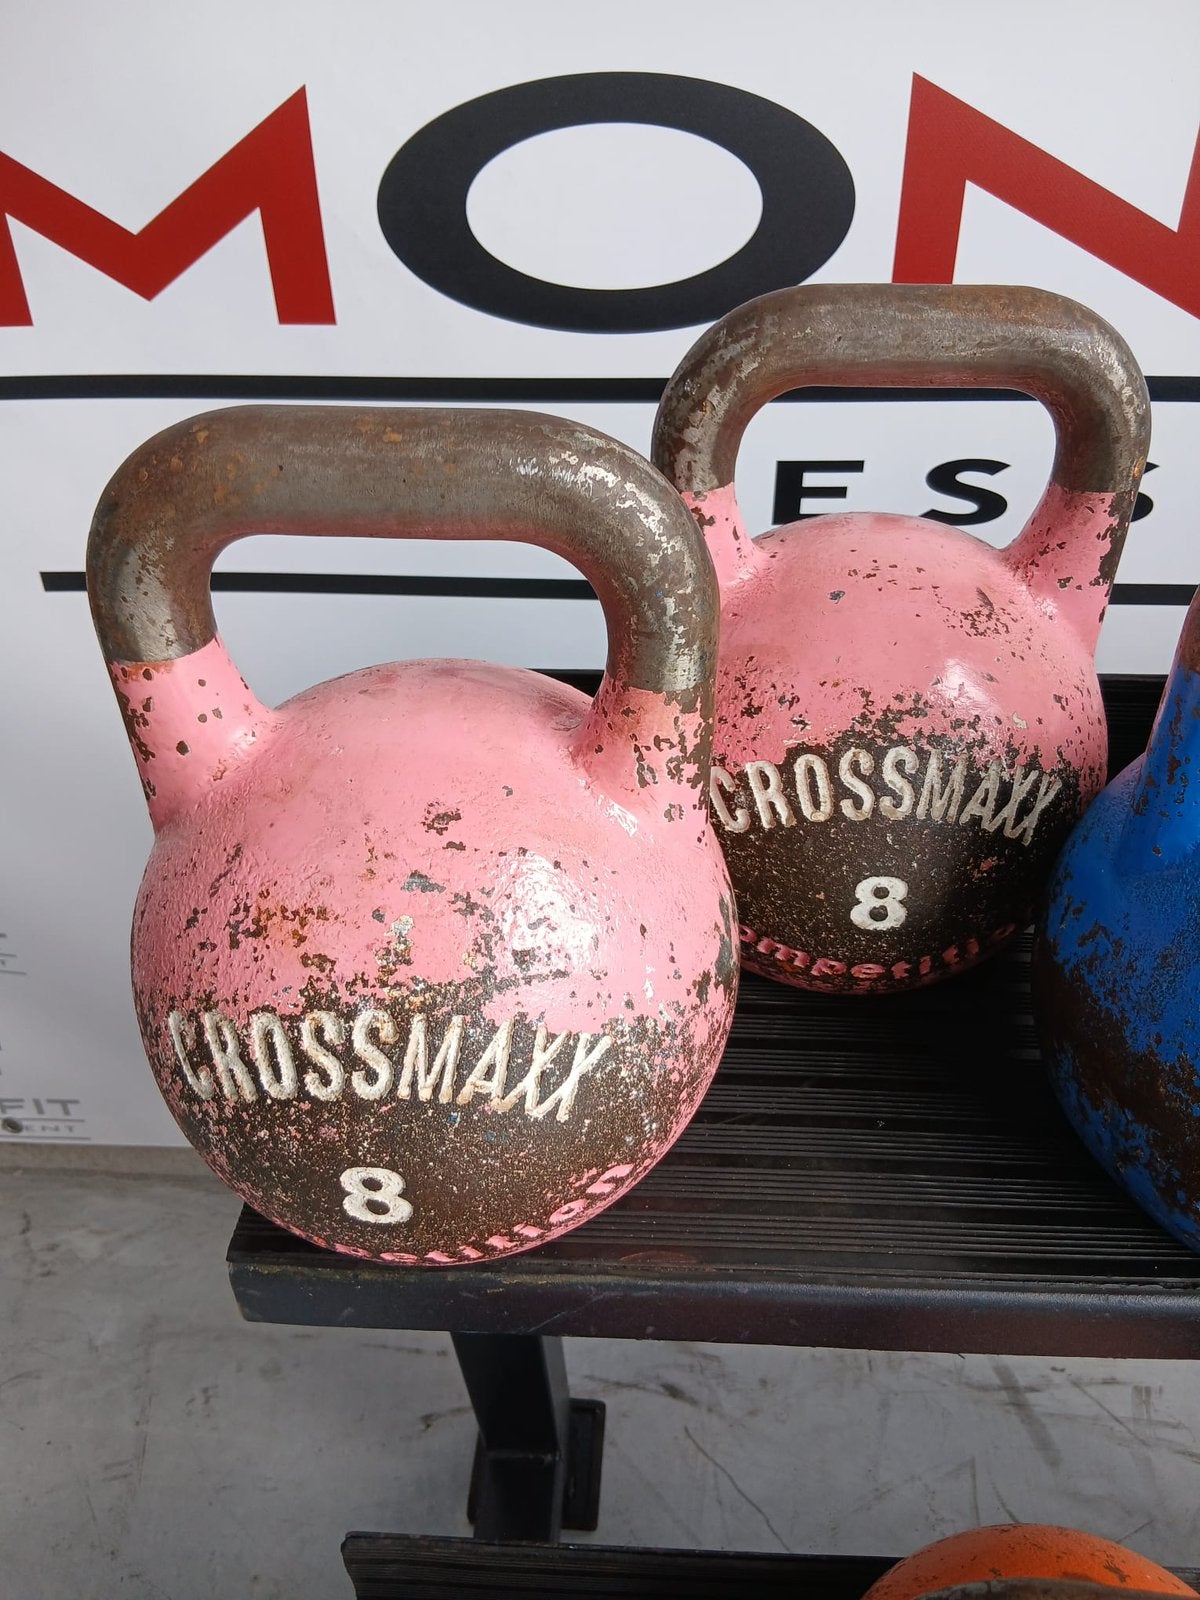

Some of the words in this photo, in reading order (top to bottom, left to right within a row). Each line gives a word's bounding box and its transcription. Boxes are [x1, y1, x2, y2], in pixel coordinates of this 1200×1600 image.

[772, 458, 1159, 526] ES
[709, 746, 1062, 846] CROSSMAXX
[850, 876, 908, 930] 8
[168, 1007, 612, 1122] CROSSMAXX
[339, 1167, 413, 1225] 8
